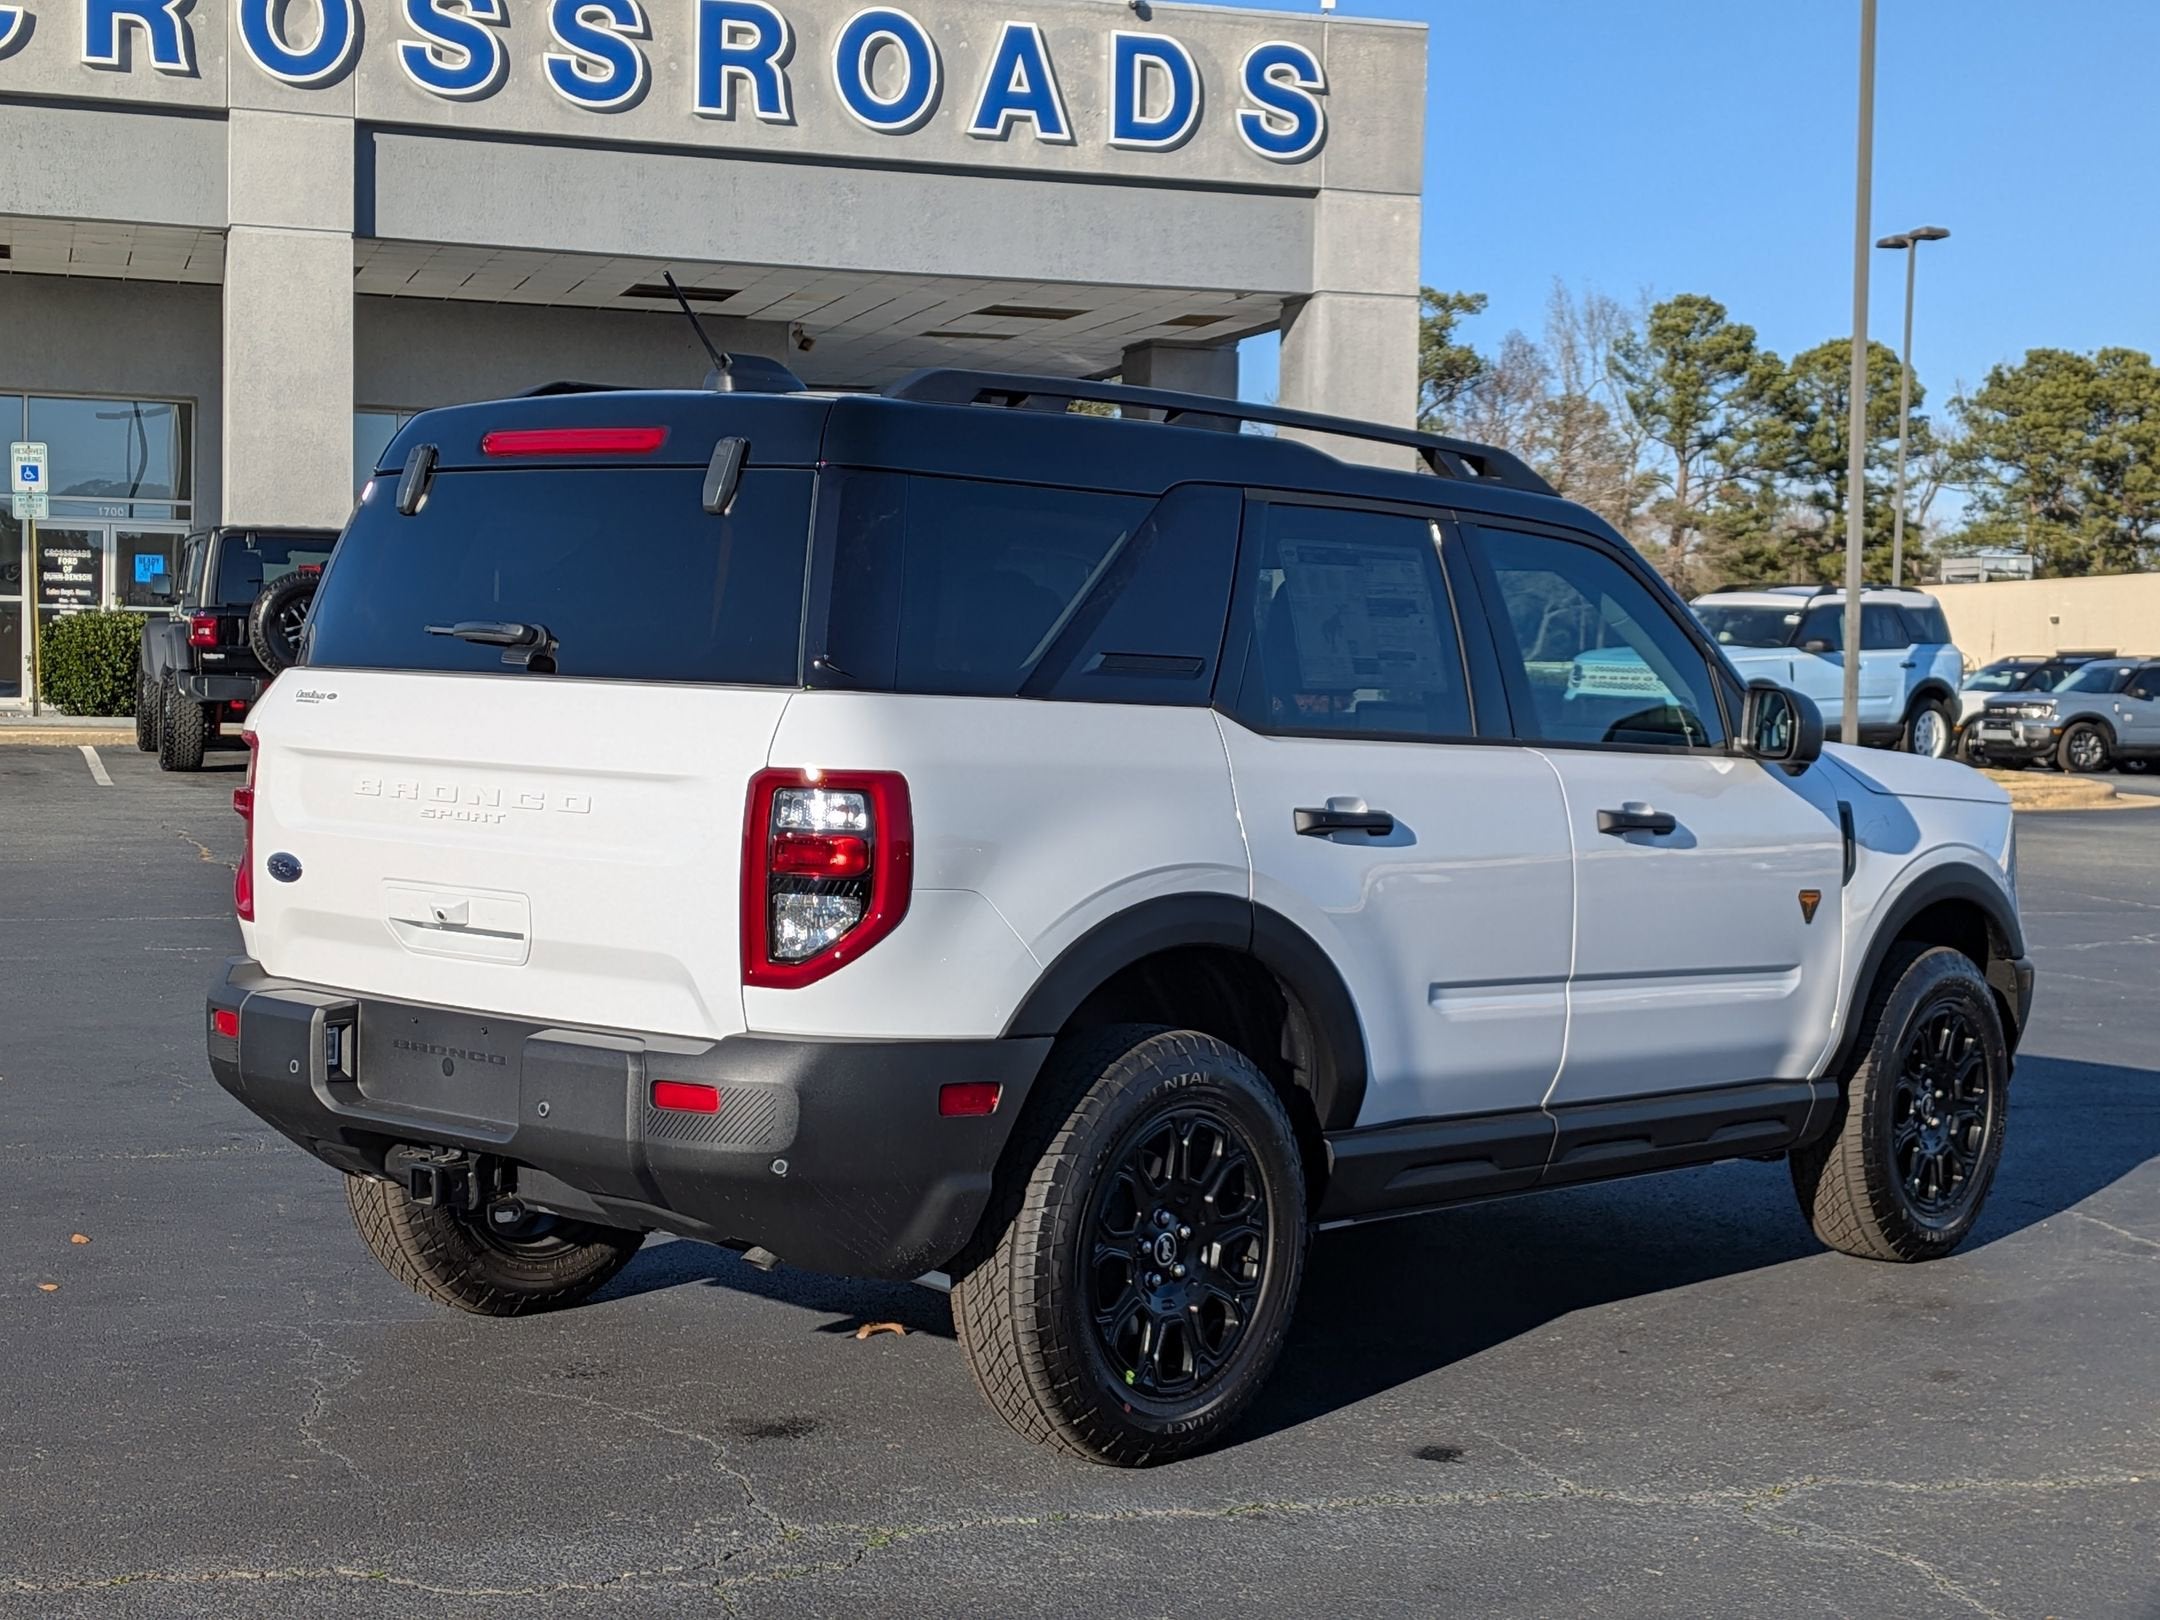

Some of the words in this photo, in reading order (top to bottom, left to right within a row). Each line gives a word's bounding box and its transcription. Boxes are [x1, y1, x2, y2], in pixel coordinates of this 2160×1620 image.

[0, 0, 1326, 159] ROSSROADS
[99, 507, 124, 516] 1700
[44, 549, 92, 558] CROSSROADS
[57, 557, 78, 565] FORD
[353, 777, 593, 814] BRONCO
[419, 808, 506, 824] SPORT
[392, 1039, 508, 1066] BRONCO
